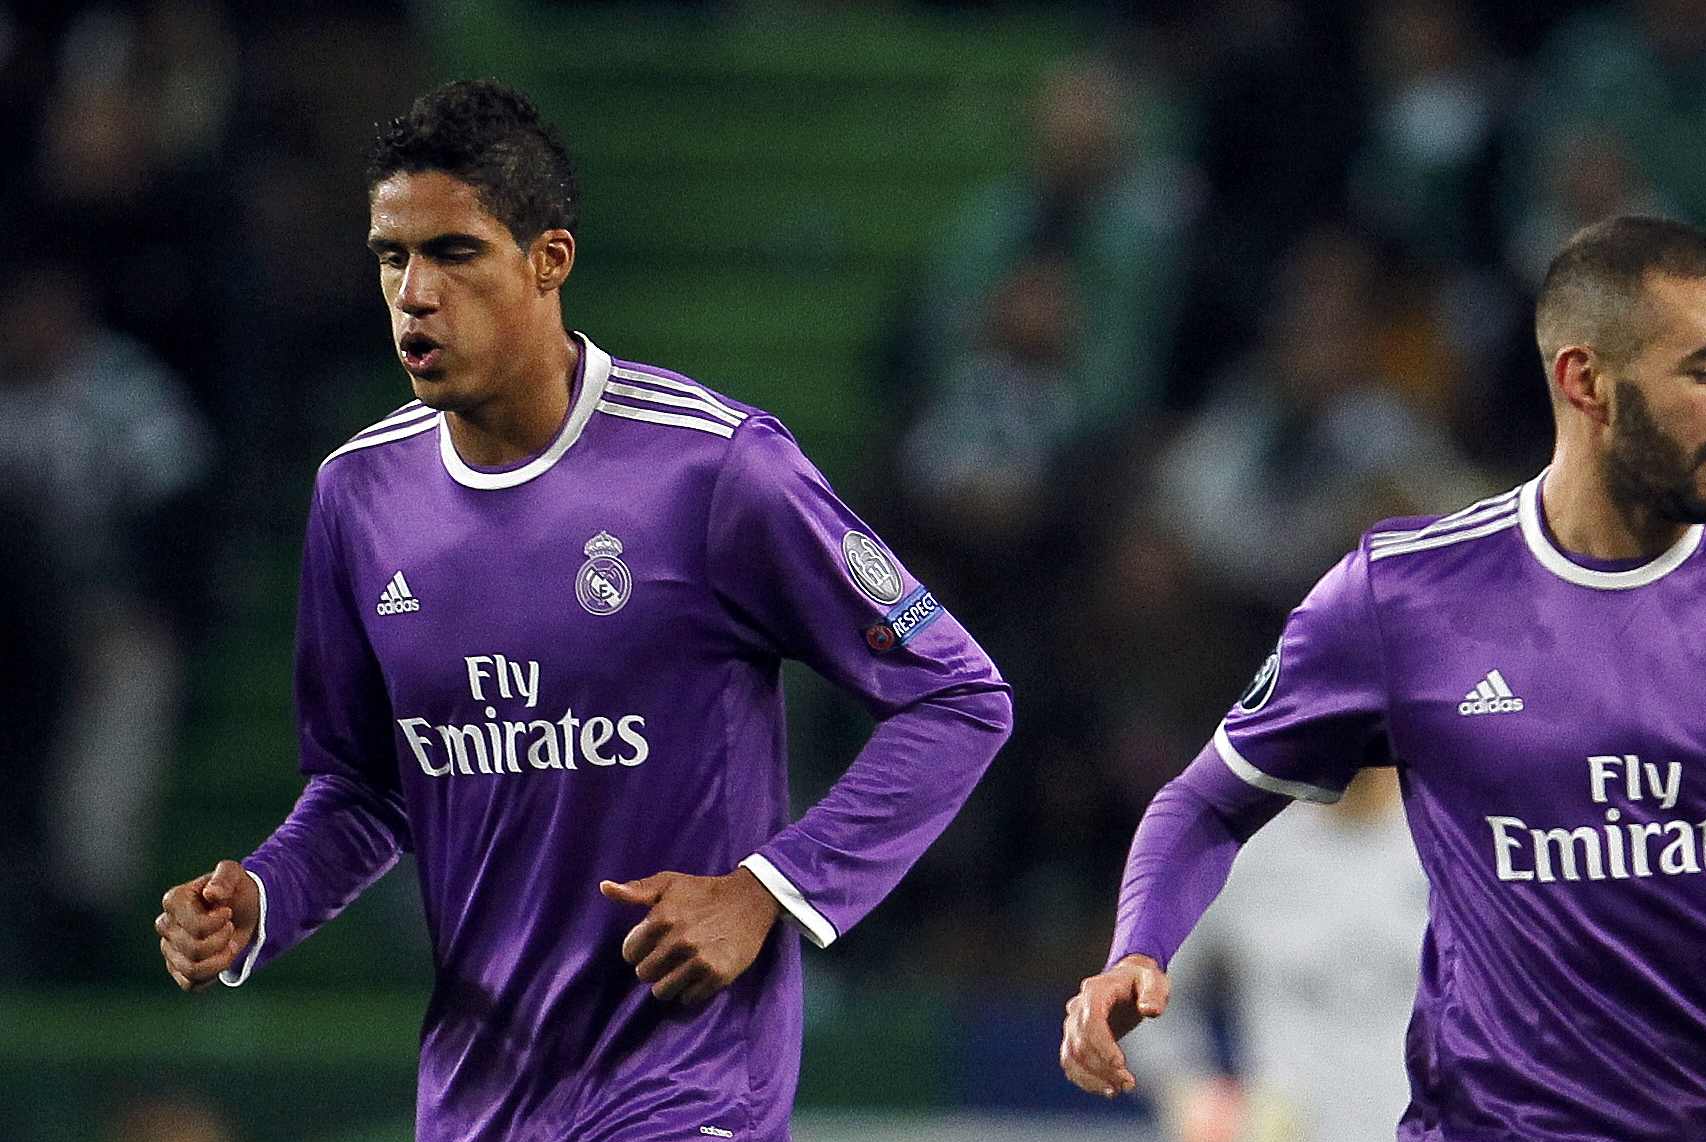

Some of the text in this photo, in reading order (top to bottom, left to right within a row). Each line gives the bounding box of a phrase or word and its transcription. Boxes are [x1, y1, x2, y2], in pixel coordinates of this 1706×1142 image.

[376, 598, 420, 616] adidas
[891, 591, 939, 638] RESPECT
[464, 653, 540, 708] Fly
[1458, 697, 1525, 716] adidas
[397, 706, 650, 777] Emirates
[1587, 754, 1683, 809] Fly
